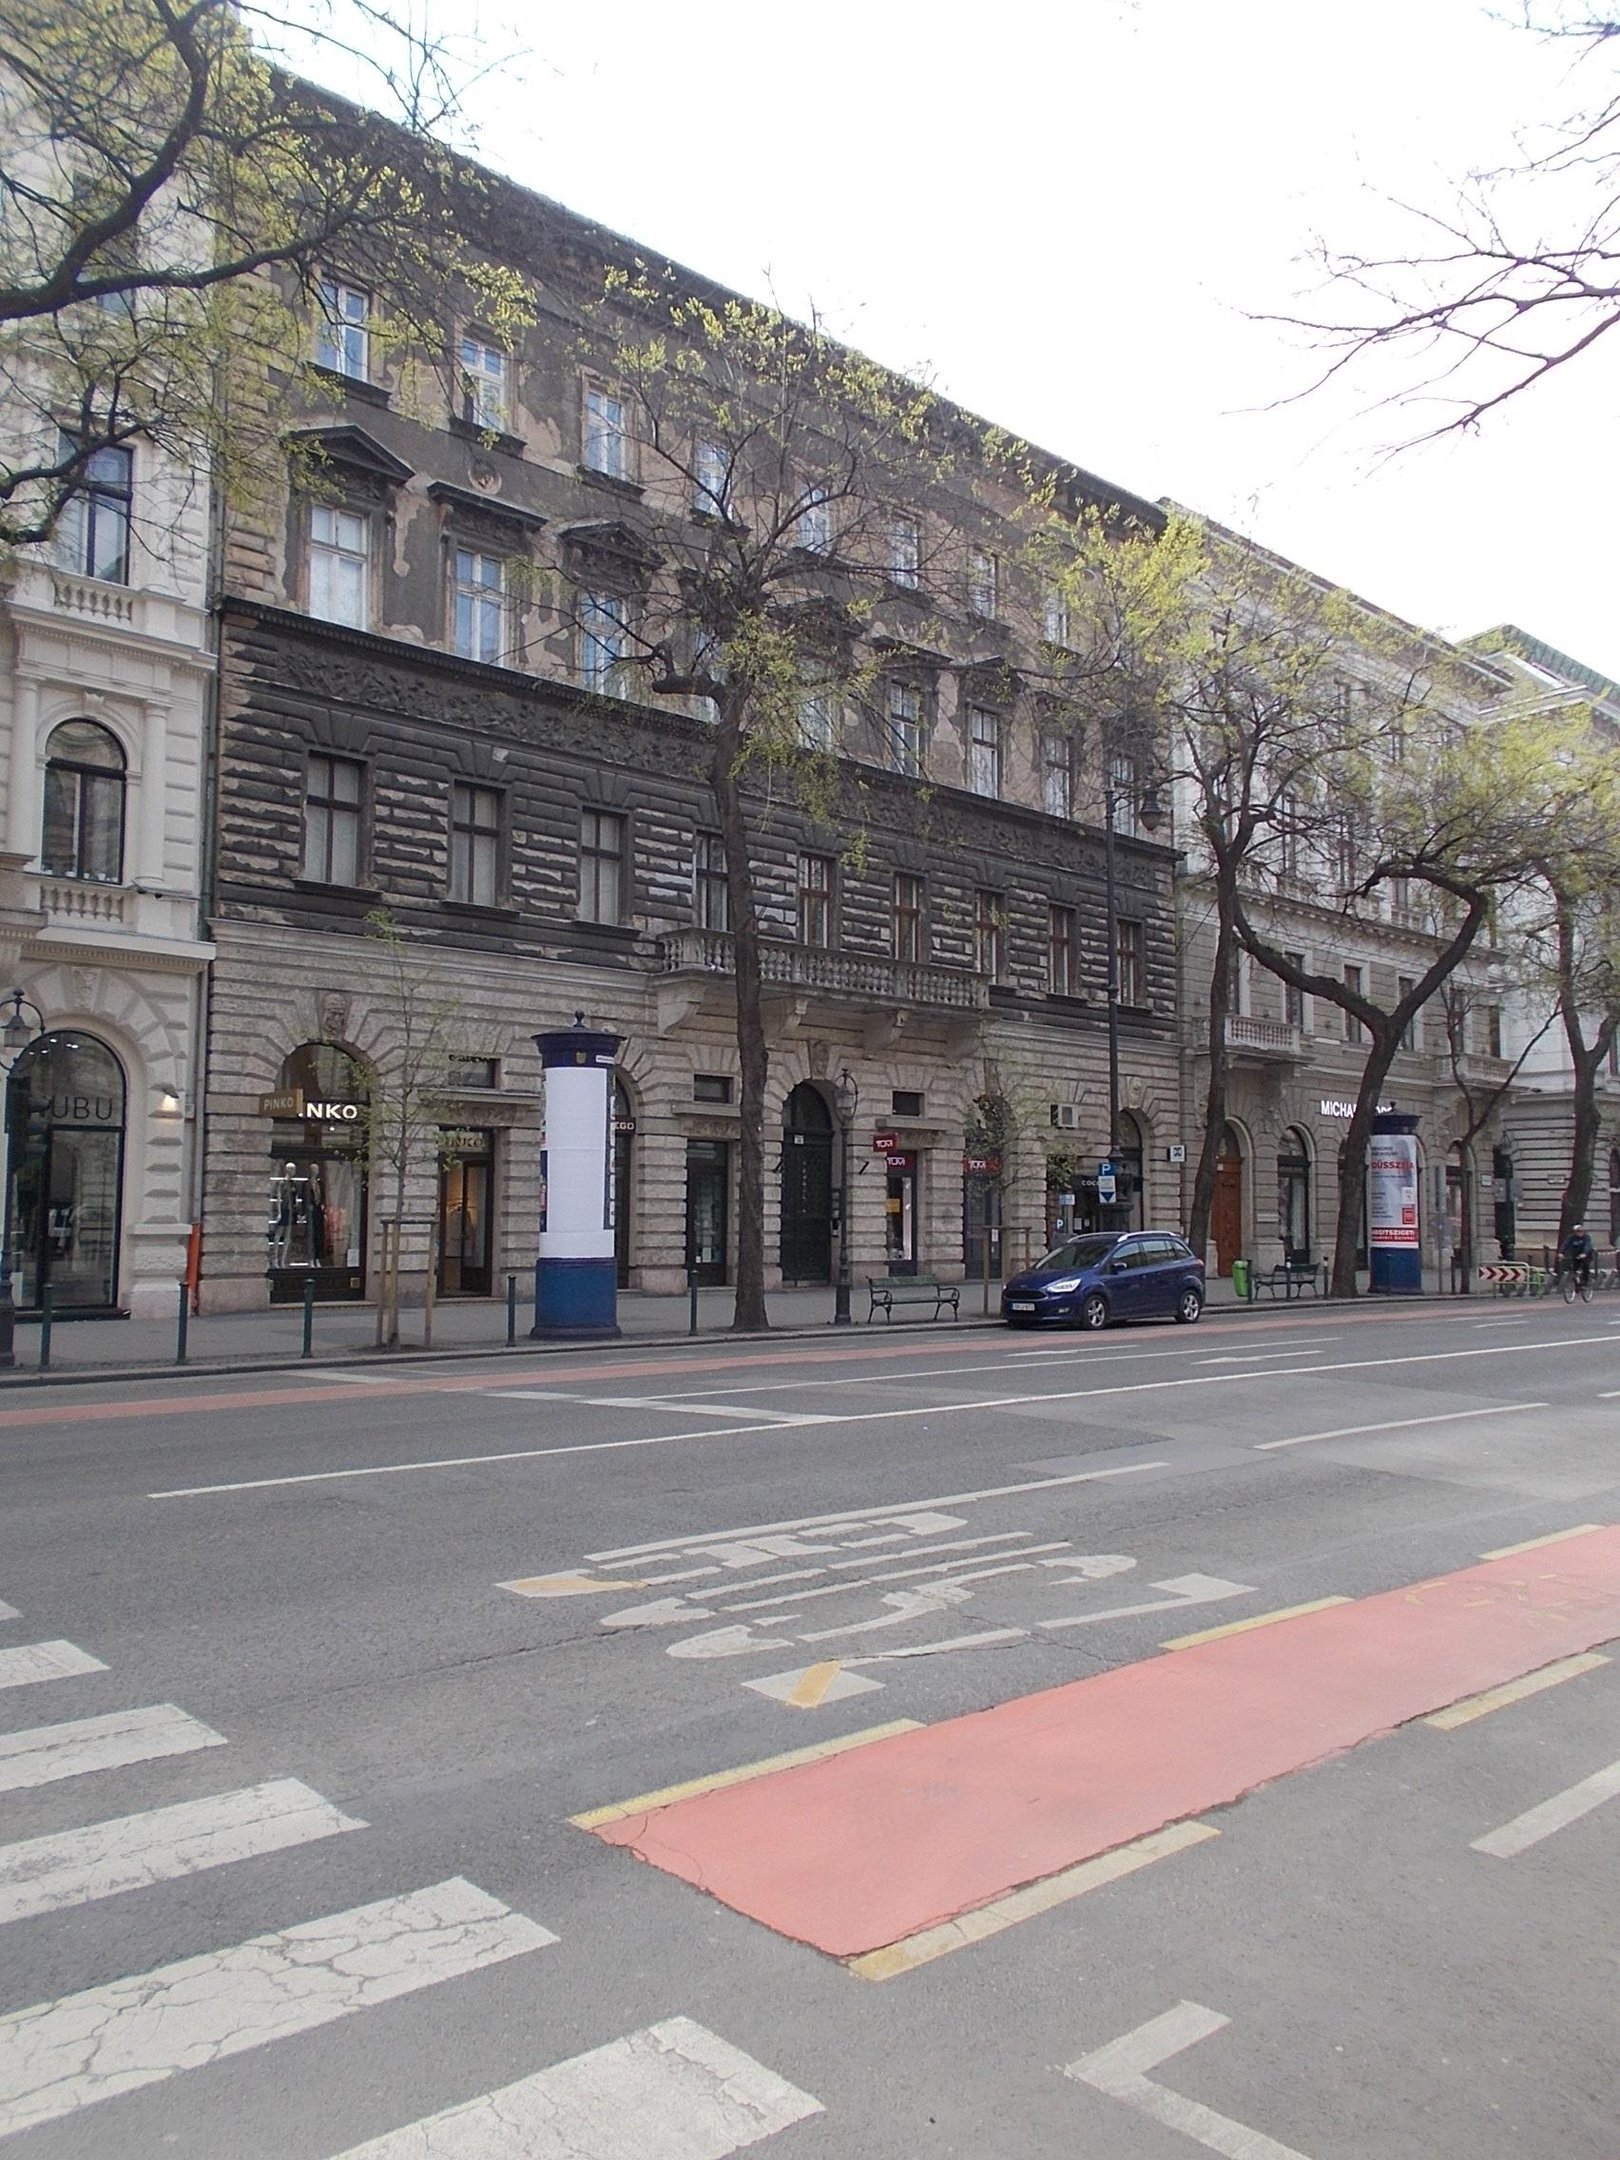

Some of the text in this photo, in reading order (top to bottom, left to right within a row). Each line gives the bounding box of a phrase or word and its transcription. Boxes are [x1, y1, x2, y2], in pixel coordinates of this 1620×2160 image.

[40, 1095, 113, 1120] UBU
[263, 1096, 294, 1110] PINKO
[298, 1102, 358, 1119] NKO
[1101, 1164, 1111, 1175] P
